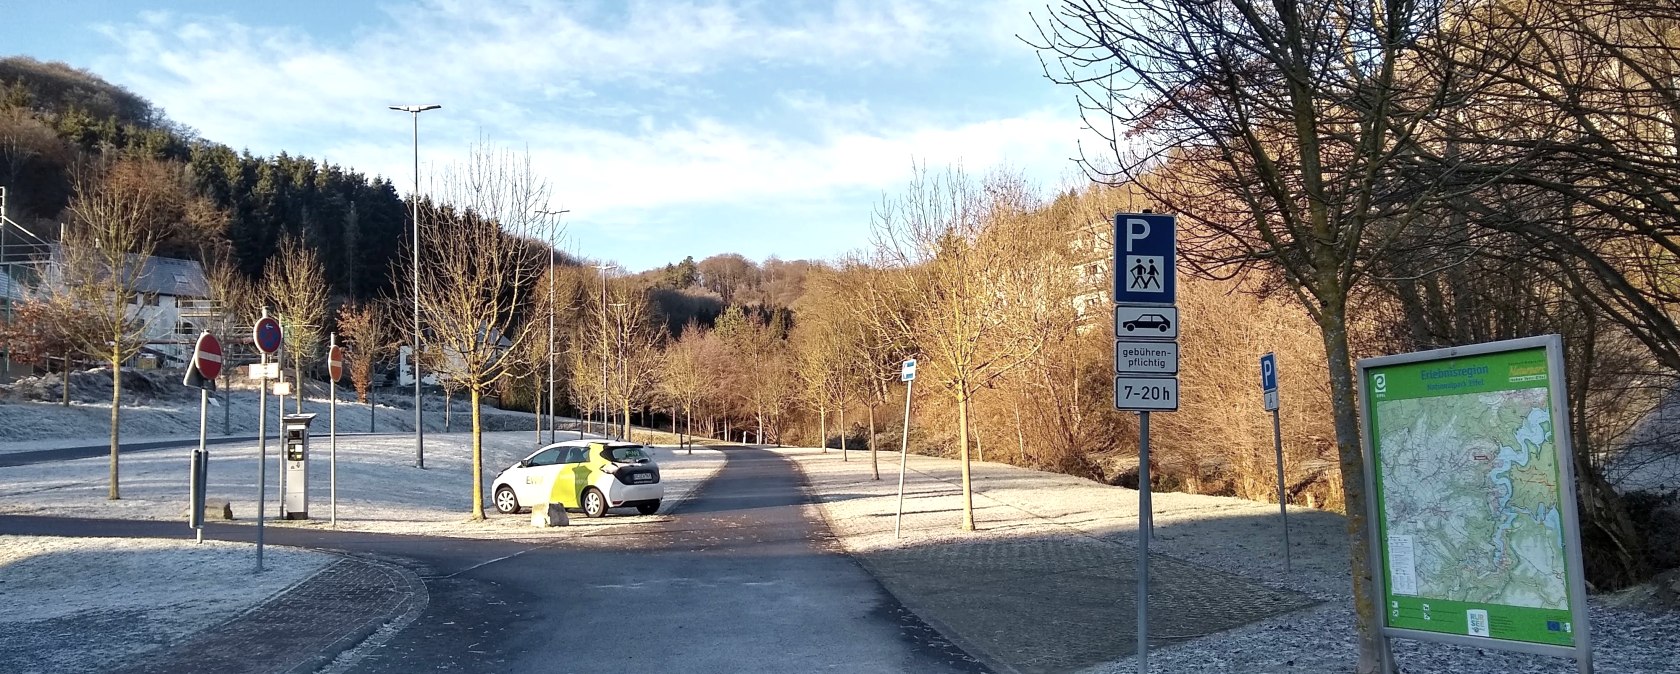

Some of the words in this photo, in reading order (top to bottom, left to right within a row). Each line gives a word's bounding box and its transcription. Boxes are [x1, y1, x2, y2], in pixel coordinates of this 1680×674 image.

[1126, 218, 1151, 252] P
[1122, 348, 1172, 358] gebühren-
[1128, 358, 1166, 369] pflichtig
[1263, 359, 1272, 387] P
[1421, 365, 1489, 380] Erlebnisregion
